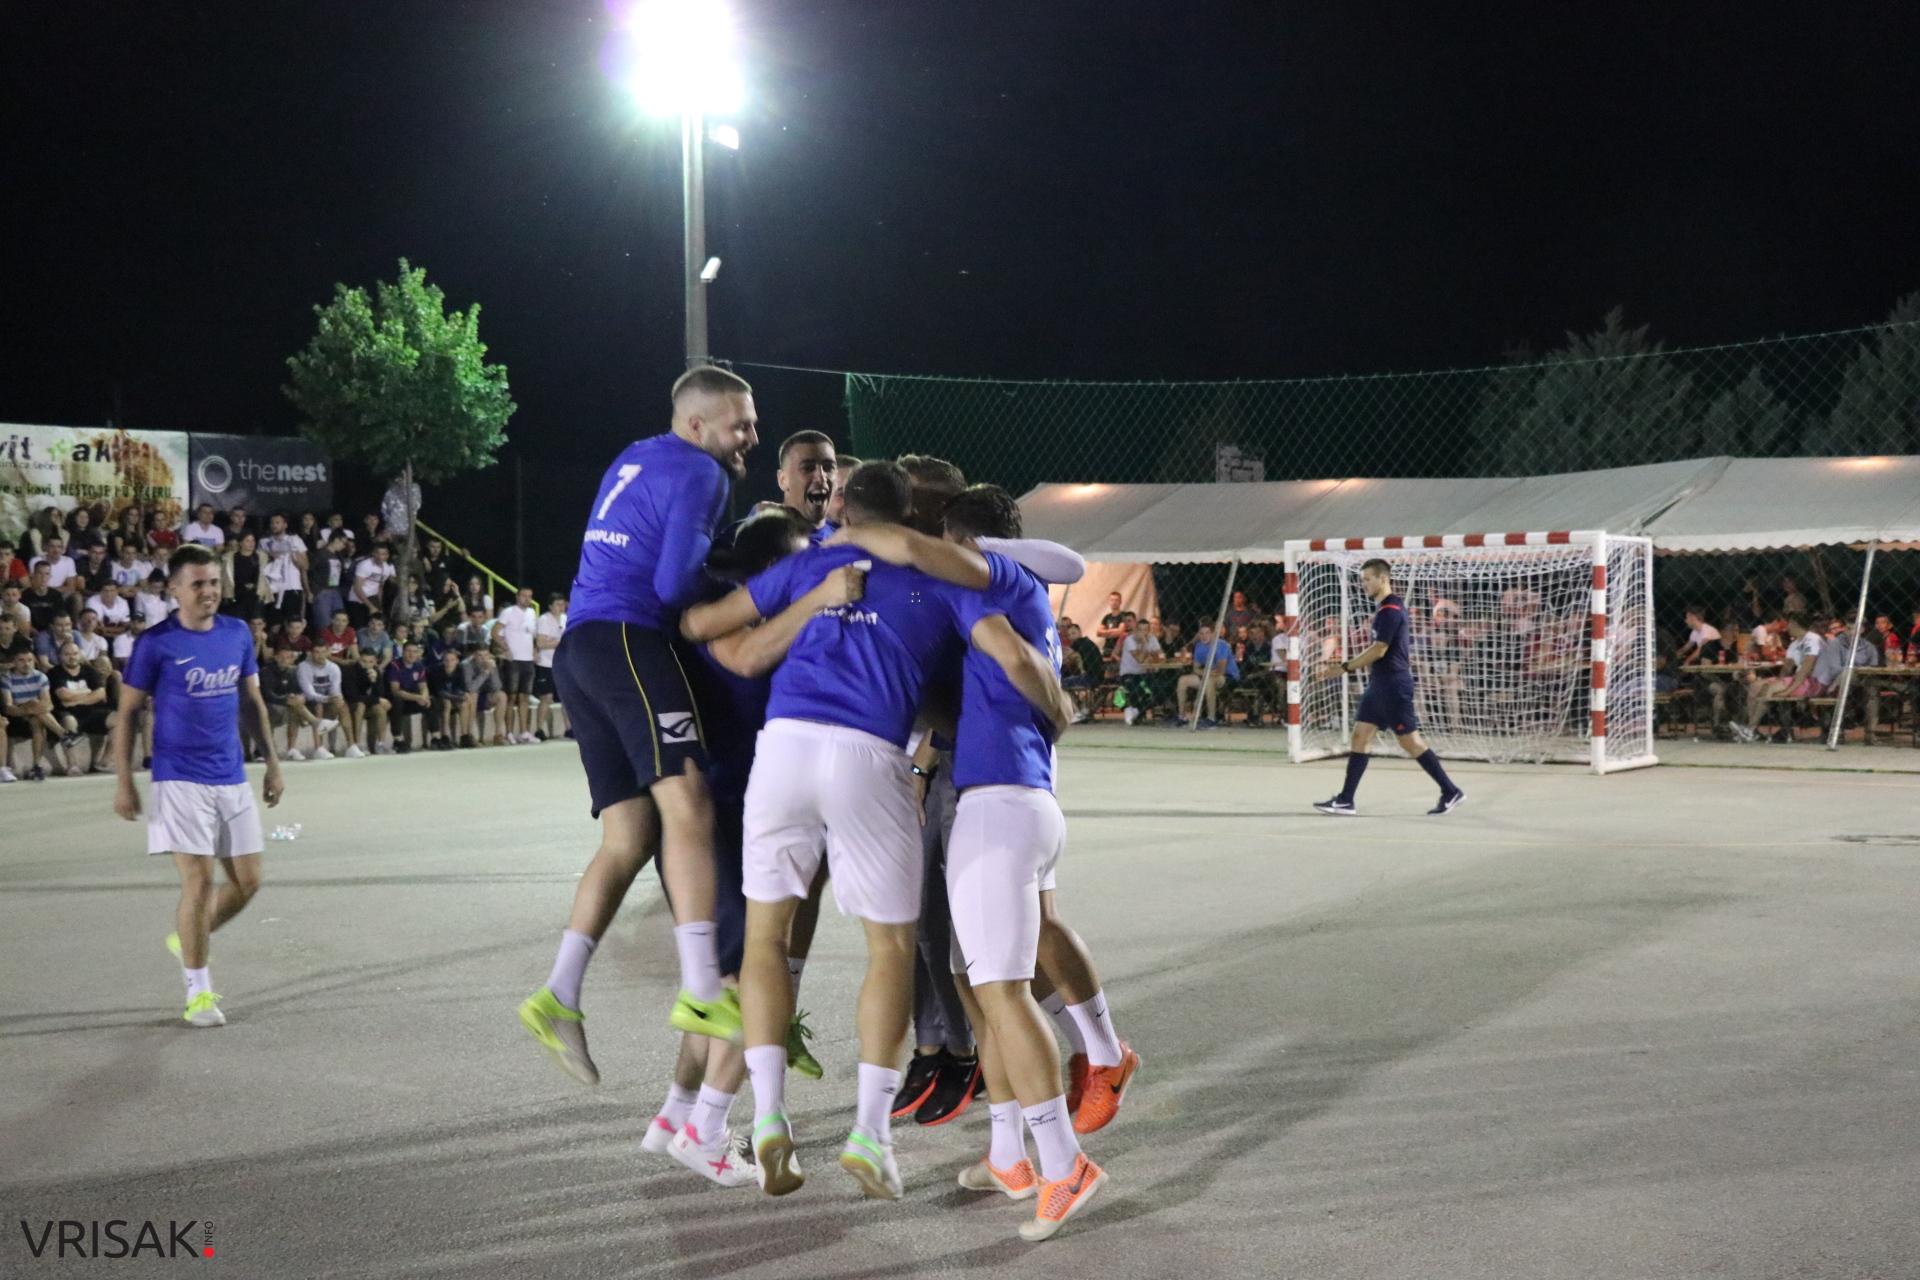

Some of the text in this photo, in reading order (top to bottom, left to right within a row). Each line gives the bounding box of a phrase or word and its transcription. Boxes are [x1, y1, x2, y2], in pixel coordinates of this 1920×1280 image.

[257, 484, 308, 494] lounge bar
[596, 464, 642, 521] 7
